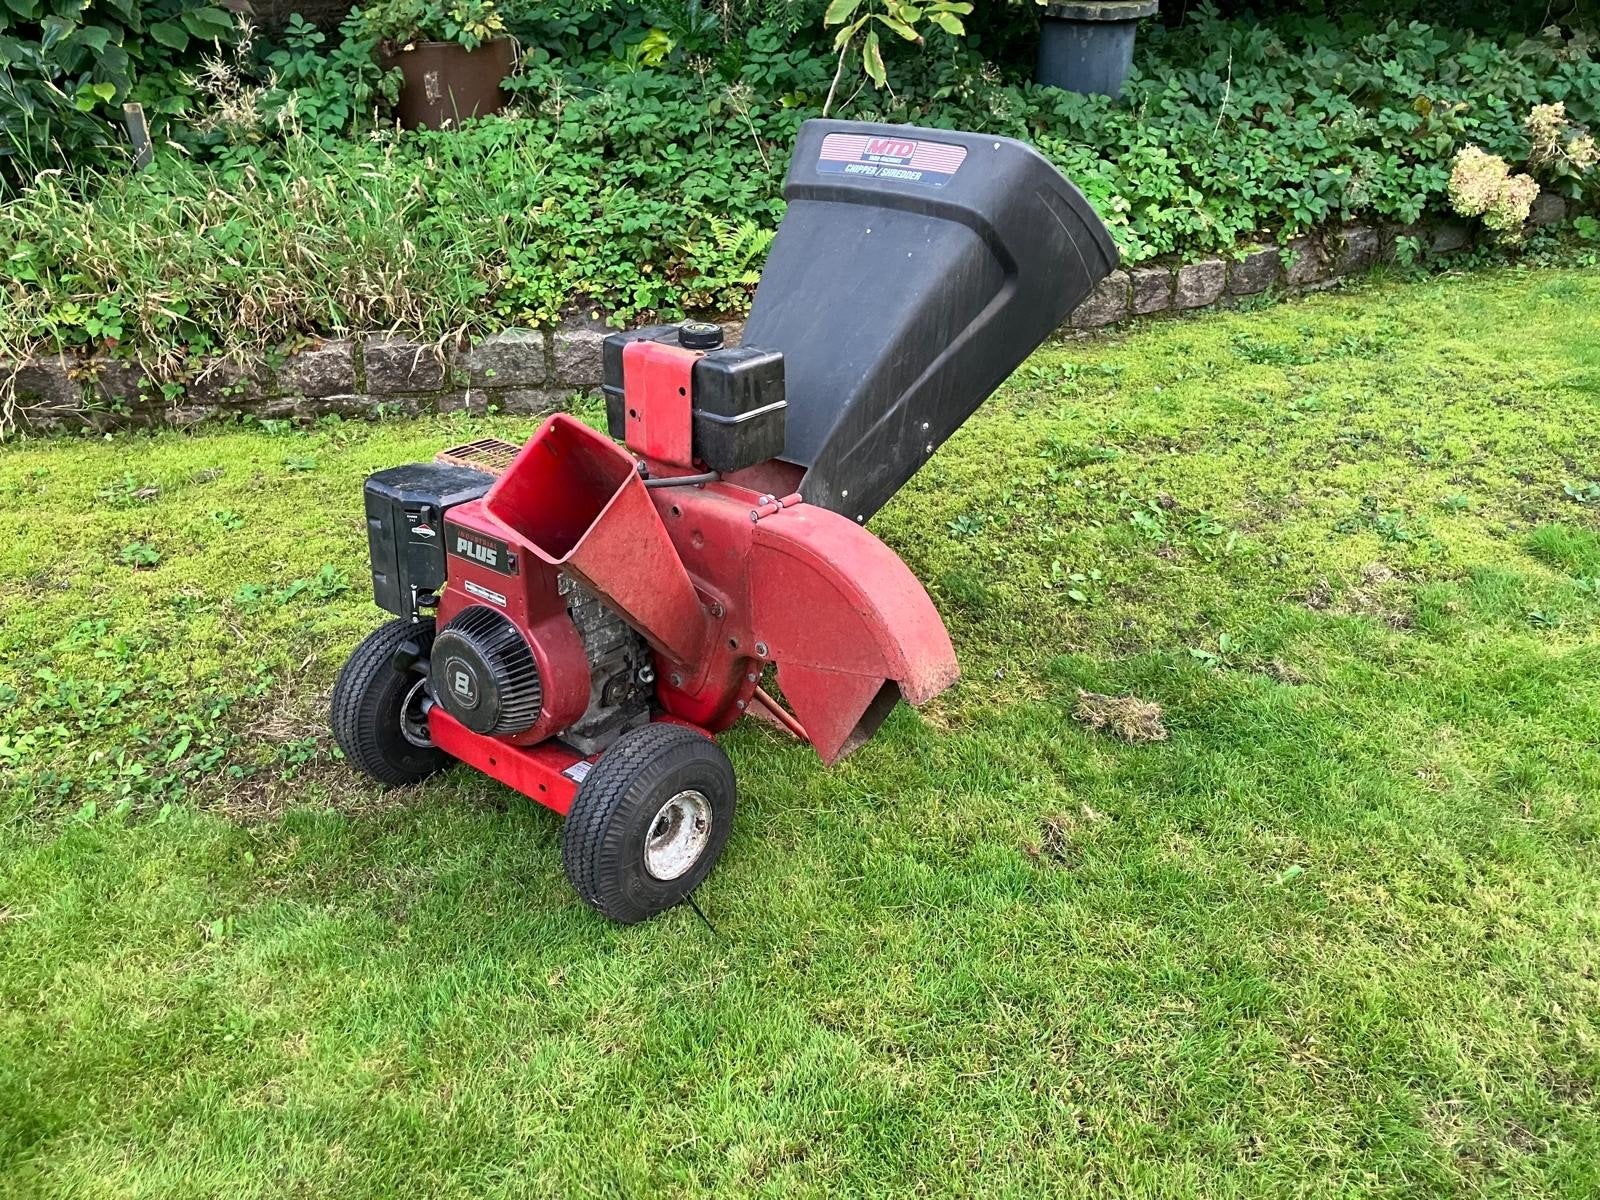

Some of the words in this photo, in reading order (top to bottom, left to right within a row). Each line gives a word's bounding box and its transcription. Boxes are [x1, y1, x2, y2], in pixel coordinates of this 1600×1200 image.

[868, 139, 915, 157] MTD
[457, 537, 497, 566] PLUS
[455, 671, 470, 695] 8
